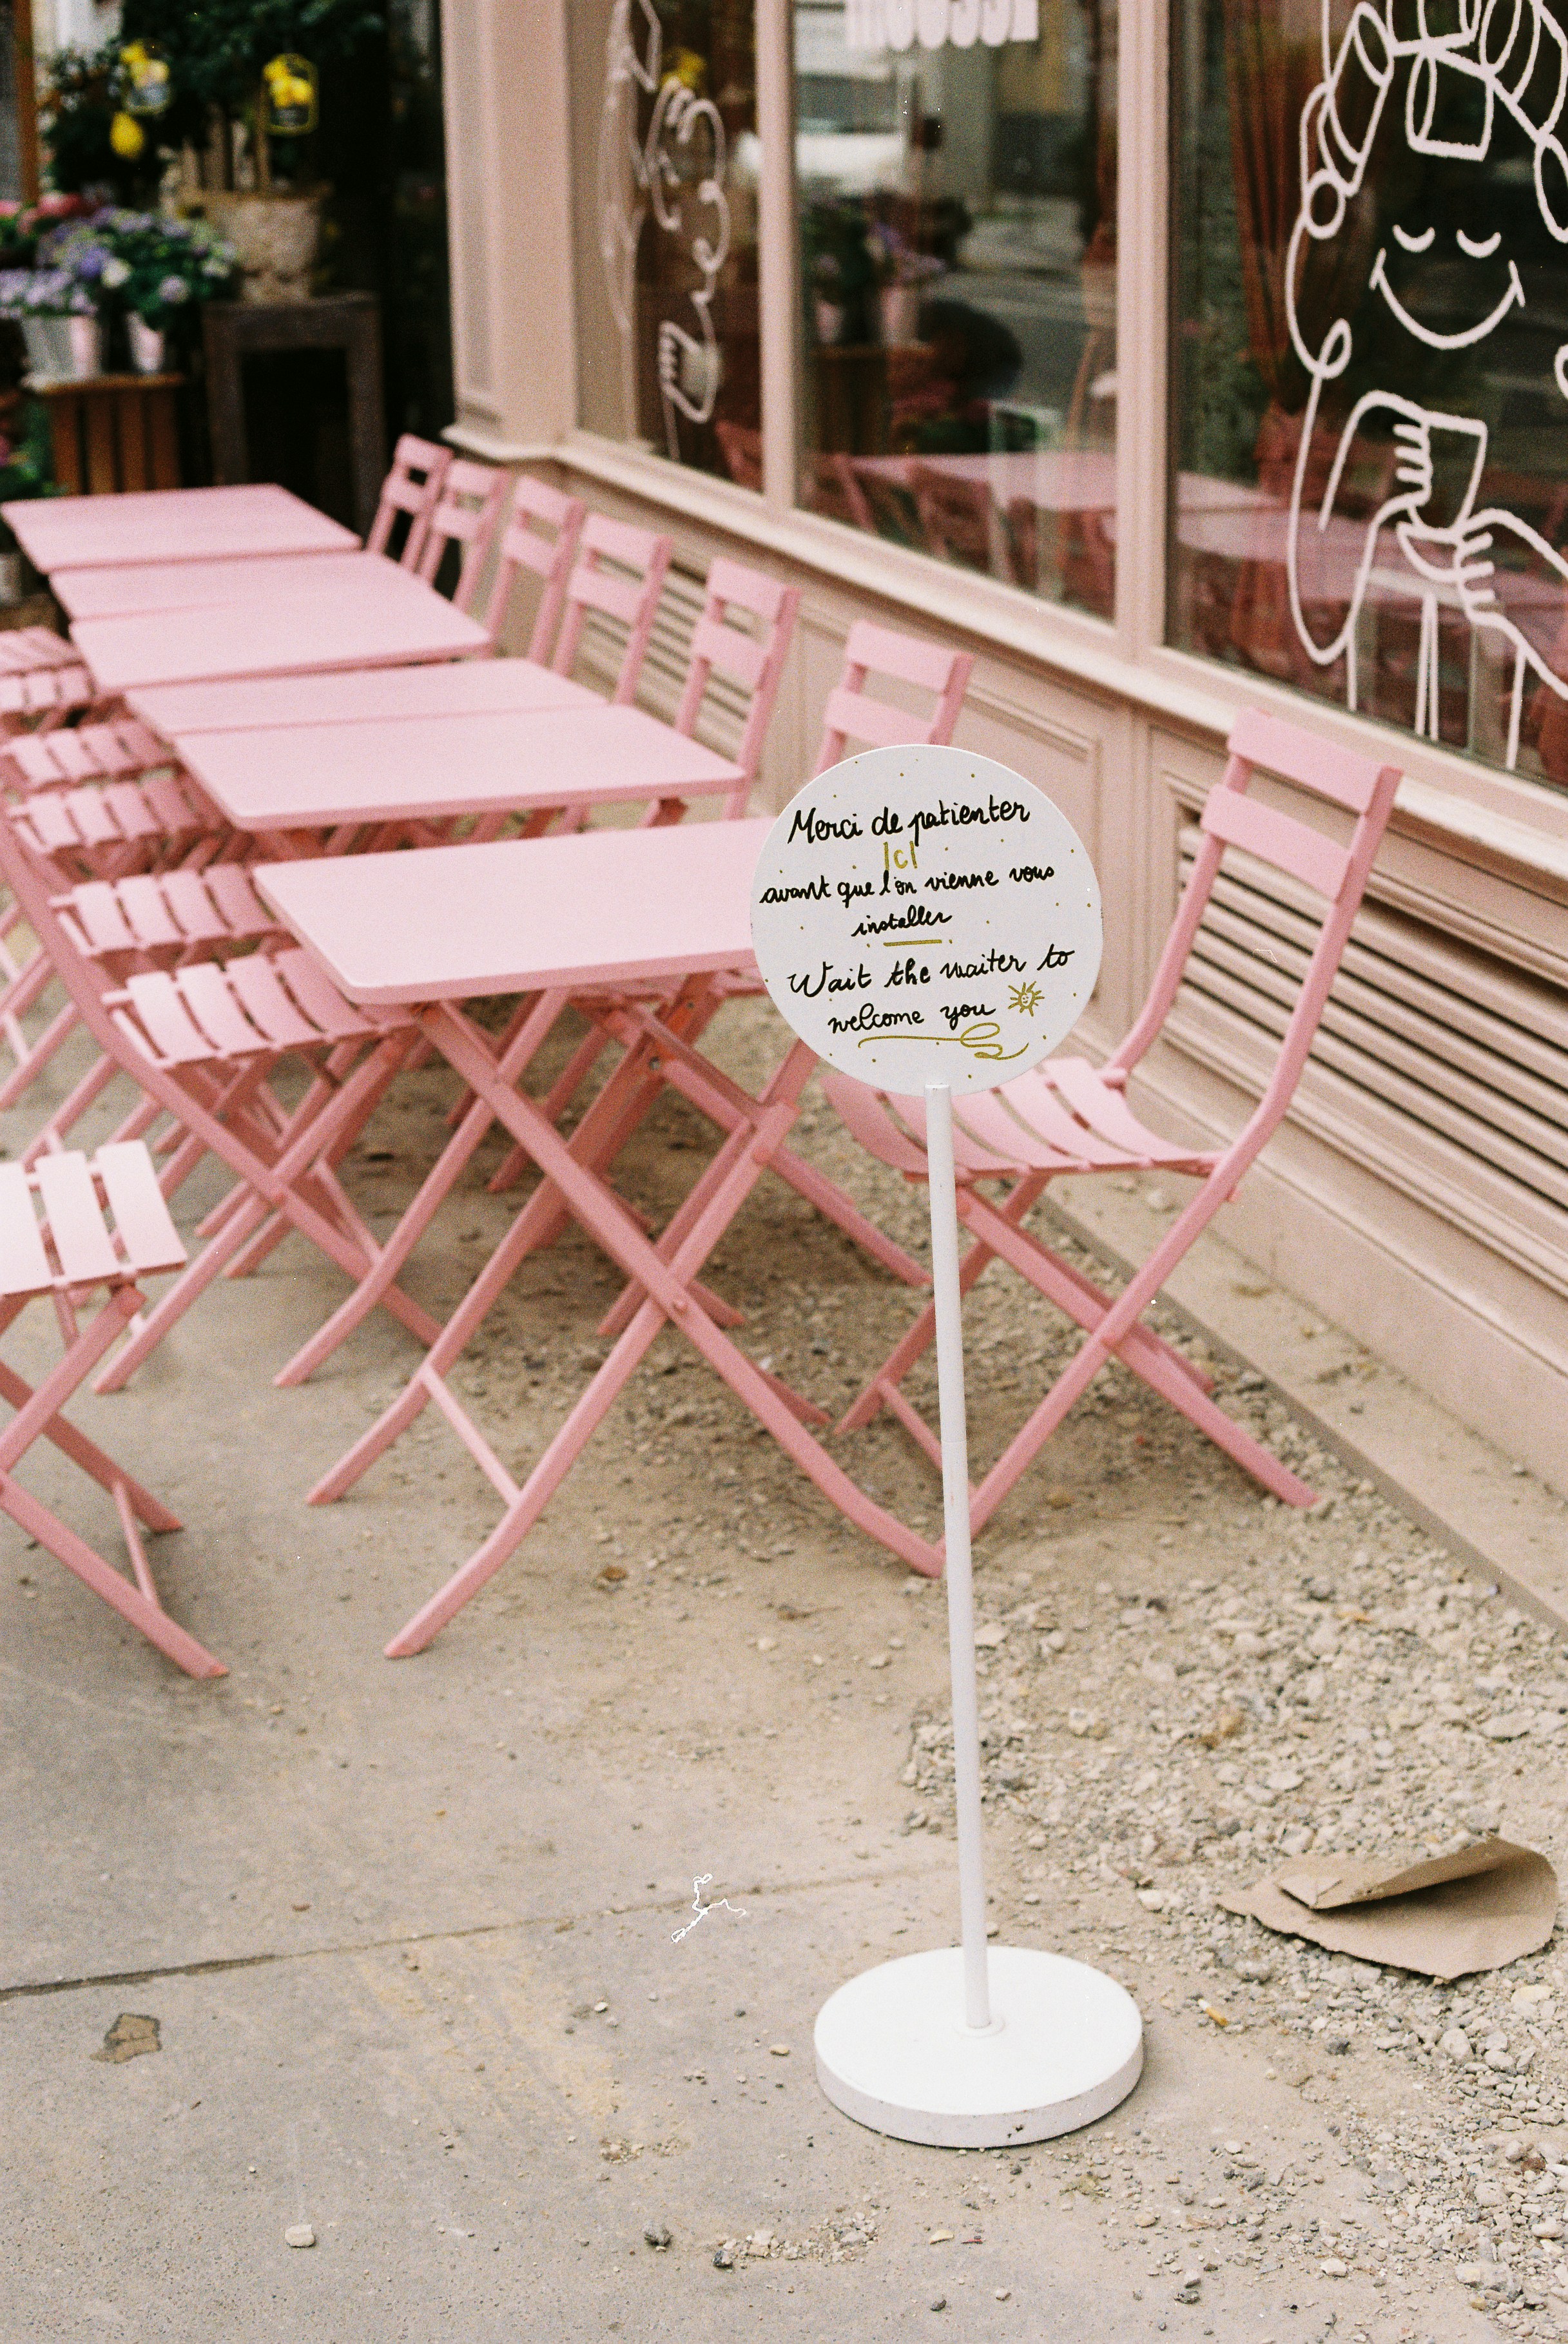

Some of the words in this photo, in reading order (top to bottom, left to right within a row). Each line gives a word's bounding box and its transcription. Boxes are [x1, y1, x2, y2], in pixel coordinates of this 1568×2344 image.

[788, 808, 863, 844] Merci
[871, 807, 903, 836] de
[907, 795, 1031, 847] patienter
[759, 875, 831, 904] avant
[837, 882, 875, 908] que
[879, 869, 917, 896] l'on
[924, 871, 999, 891] vienne
[1009, 866, 1054, 882] vous
[851, 904, 952, 937] installer
[787, 961, 872, 998] Wait
[884, 958, 931, 988] the
[939, 948, 1027, 979] waiter
[1036, 944, 1075, 971] to
[828, 1003, 924, 1033] welcome
[940, 1004, 996, 1031] you
